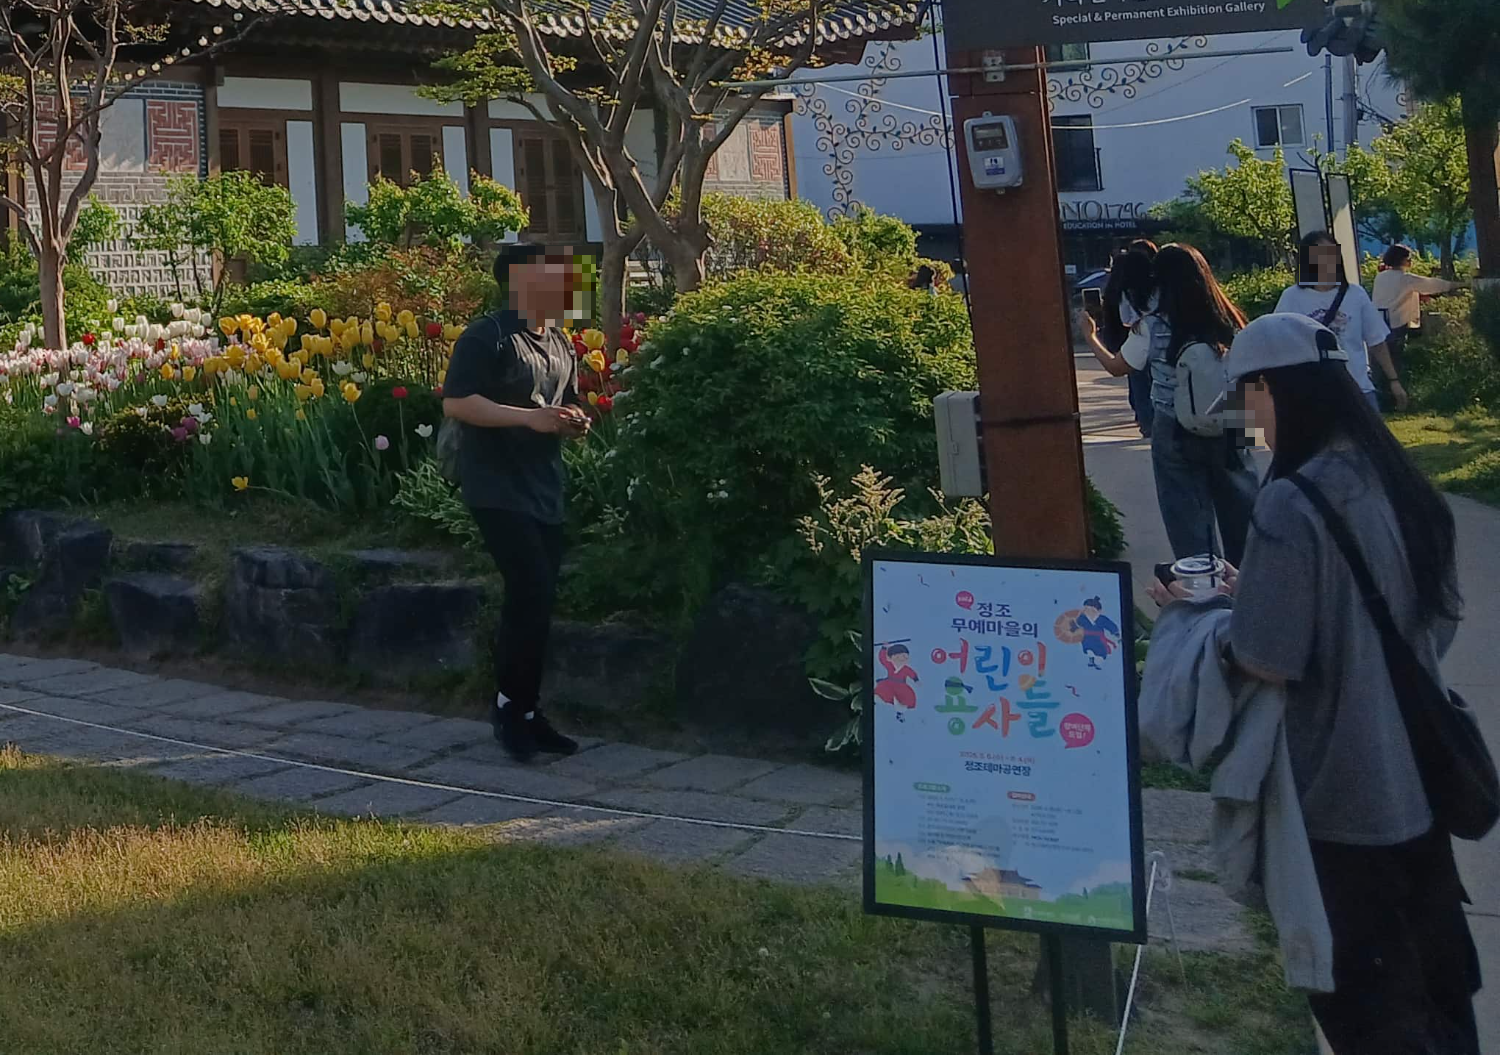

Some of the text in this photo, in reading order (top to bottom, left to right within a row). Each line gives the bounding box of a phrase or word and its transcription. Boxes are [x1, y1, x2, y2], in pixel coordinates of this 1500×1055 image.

[1052, 0, 1266, 27] Special & Permanent Exhibition Gallery
[1115, 221, 1137, 229] HOTEL
[976, 601, 1012, 618] 정조
[951, 617, 1038, 639] 무예마을의
[931, 637, 1047, 692] 어린이
[934, 675, 1061, 739] 용사들
